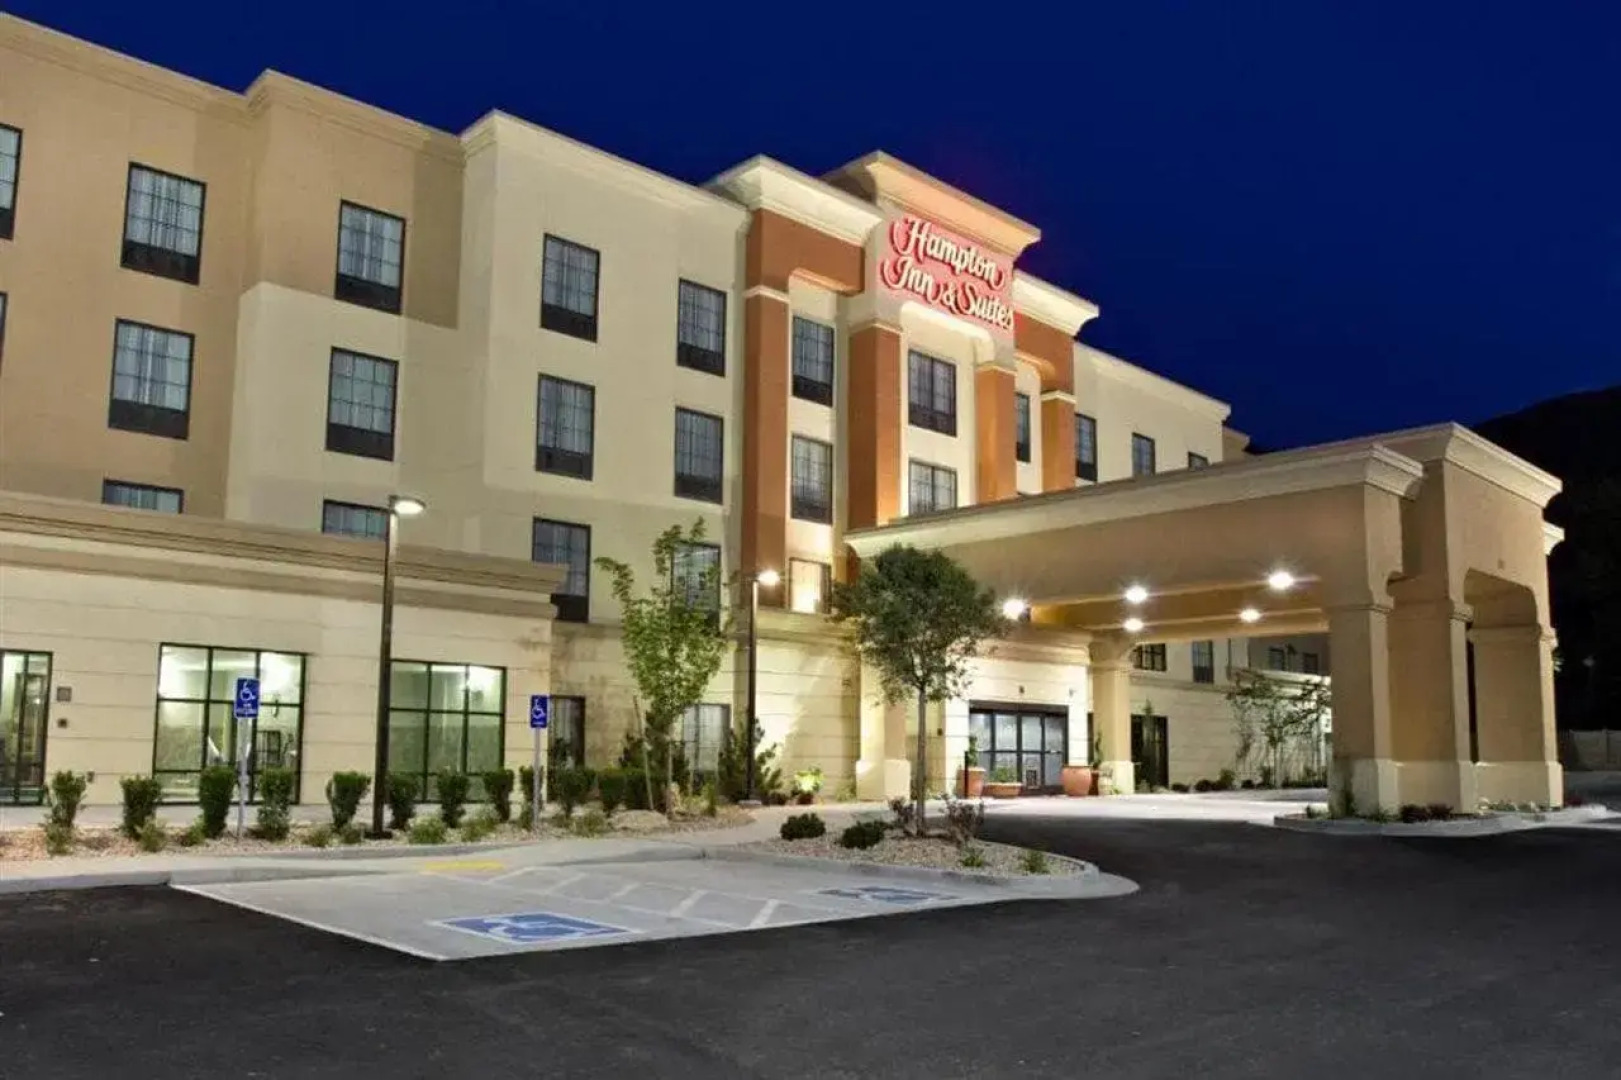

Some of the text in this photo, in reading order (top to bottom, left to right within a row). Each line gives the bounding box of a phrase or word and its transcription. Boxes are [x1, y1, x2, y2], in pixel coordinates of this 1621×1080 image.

[889, 214, 1004, 291] Hampton
[880, 256, 1014, 331] Inn & Suites
